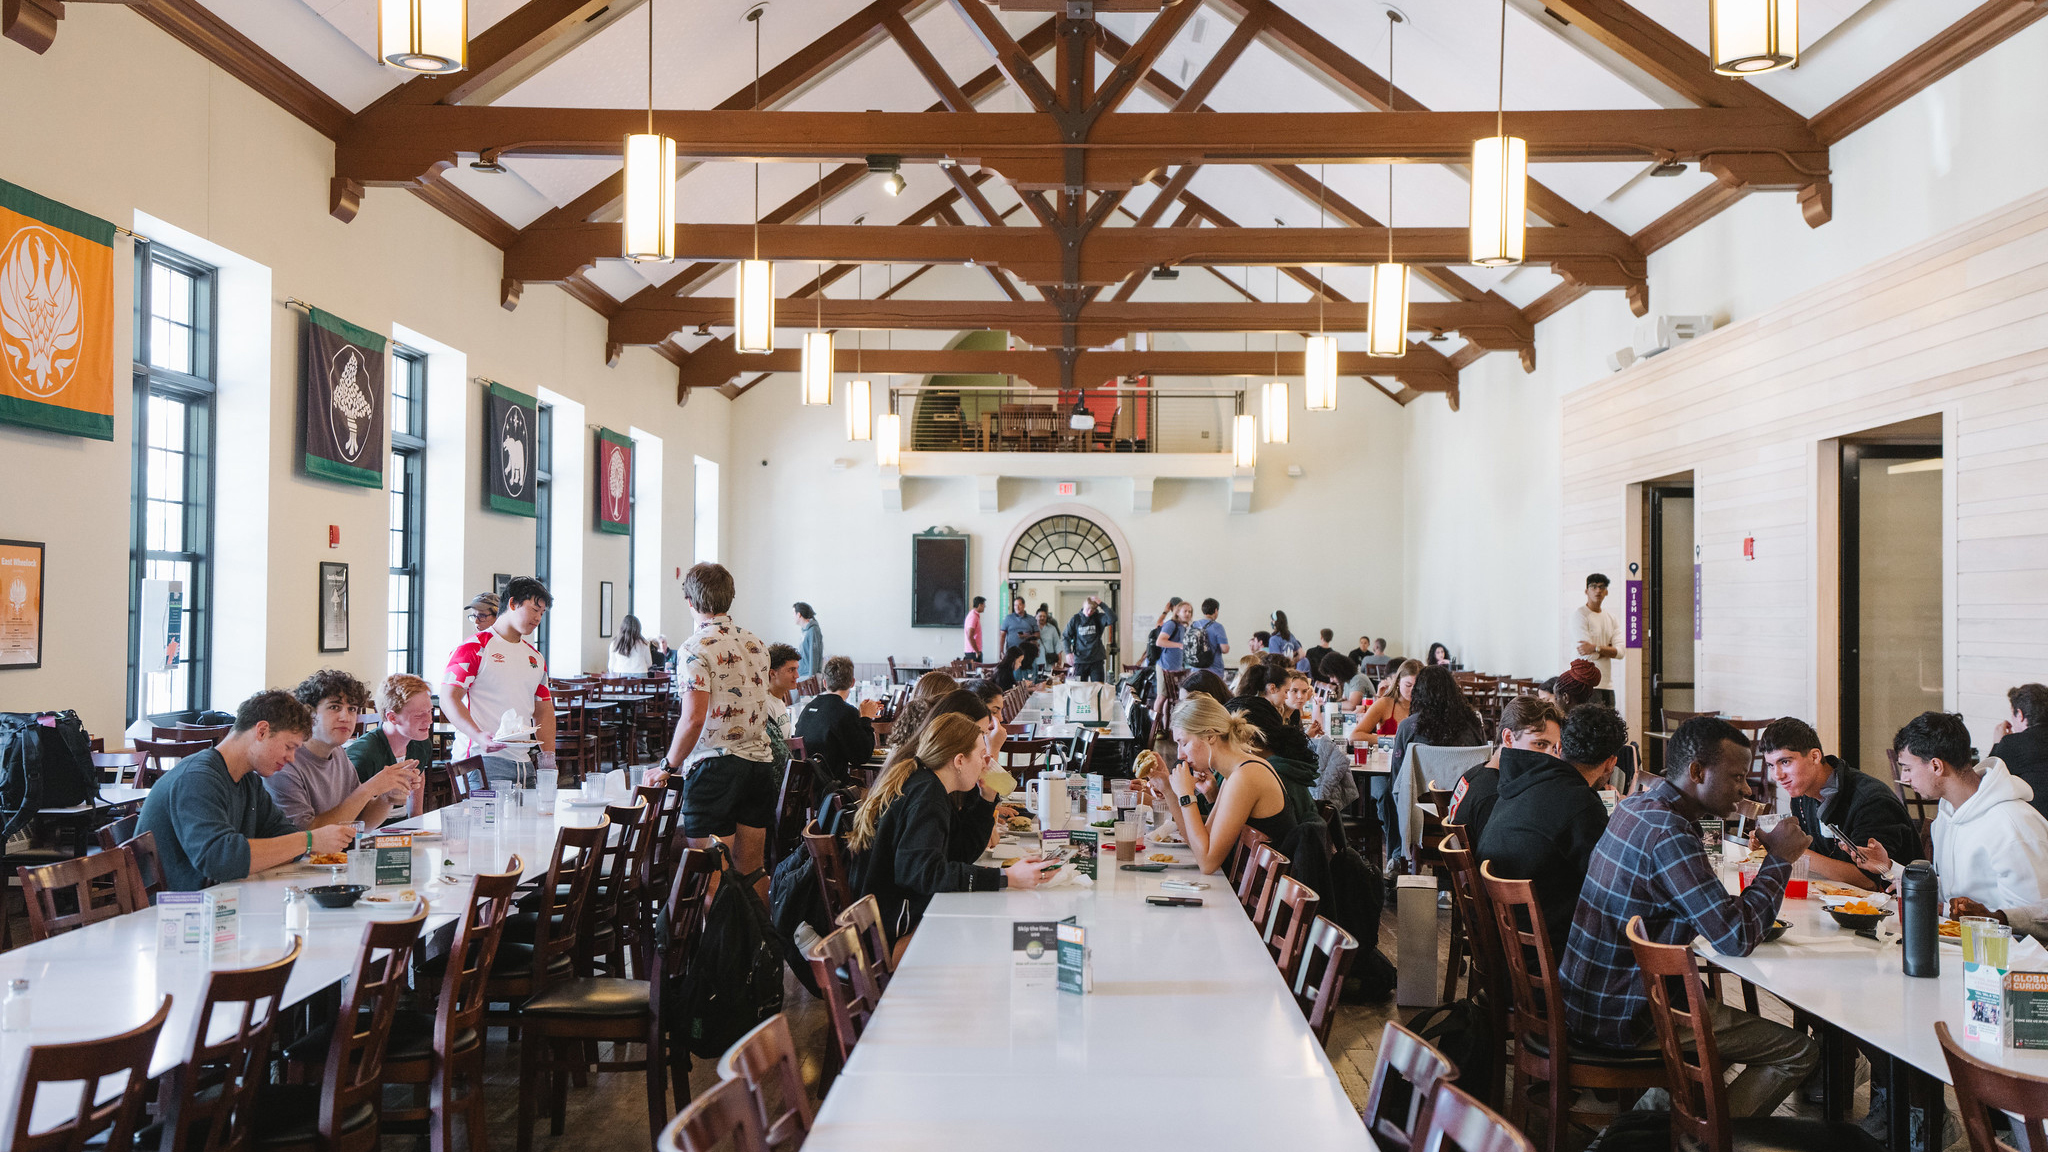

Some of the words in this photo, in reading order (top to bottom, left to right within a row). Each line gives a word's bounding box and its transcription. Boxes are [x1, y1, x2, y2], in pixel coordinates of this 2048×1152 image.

[1059, 483, 1073, 494] EXIT
[1, 557, 13, 566] East
[13, 557, 37, 567] Wheelock
[403, 837, 410, 845] ?
[2013, 982, 2048, 990] CURIOU
